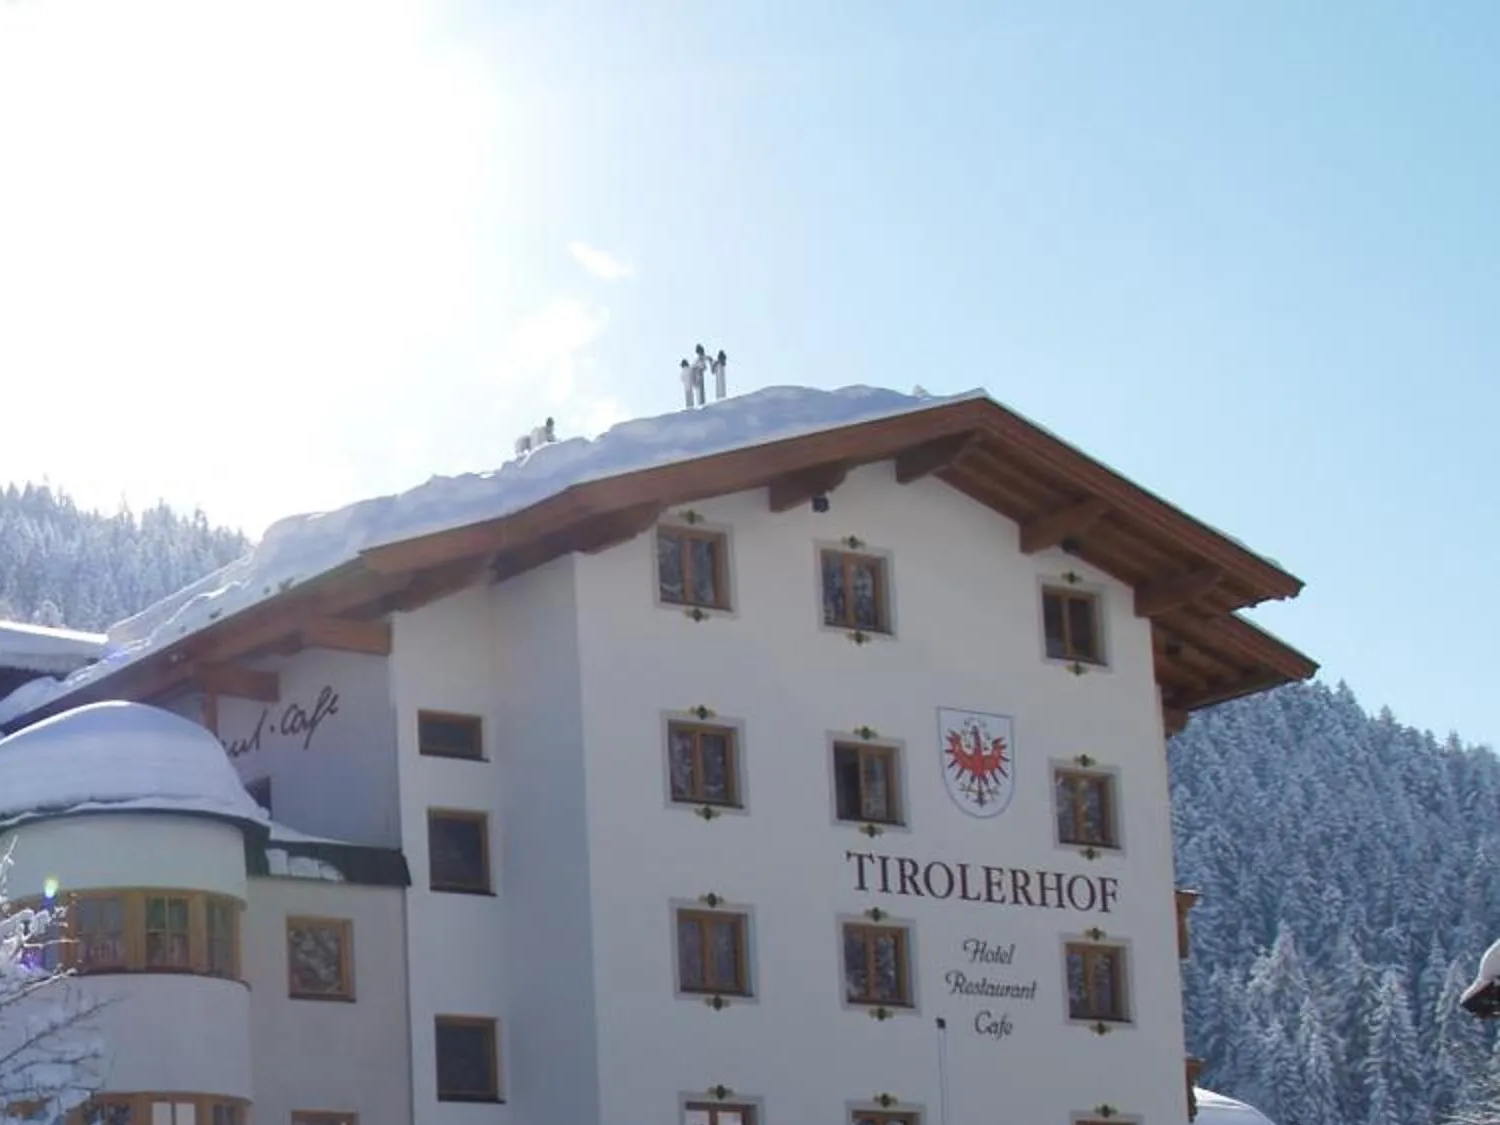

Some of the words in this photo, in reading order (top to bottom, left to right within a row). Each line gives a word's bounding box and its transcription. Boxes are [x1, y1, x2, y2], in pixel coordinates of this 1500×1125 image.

[846, 851, 1119, 913] TIROLERHOF
[963, 939, 1015, 965] Hotel
[945, 970, 1037, 1000] Restaurant
[975, 1011, 1013, 1040] Cafe
